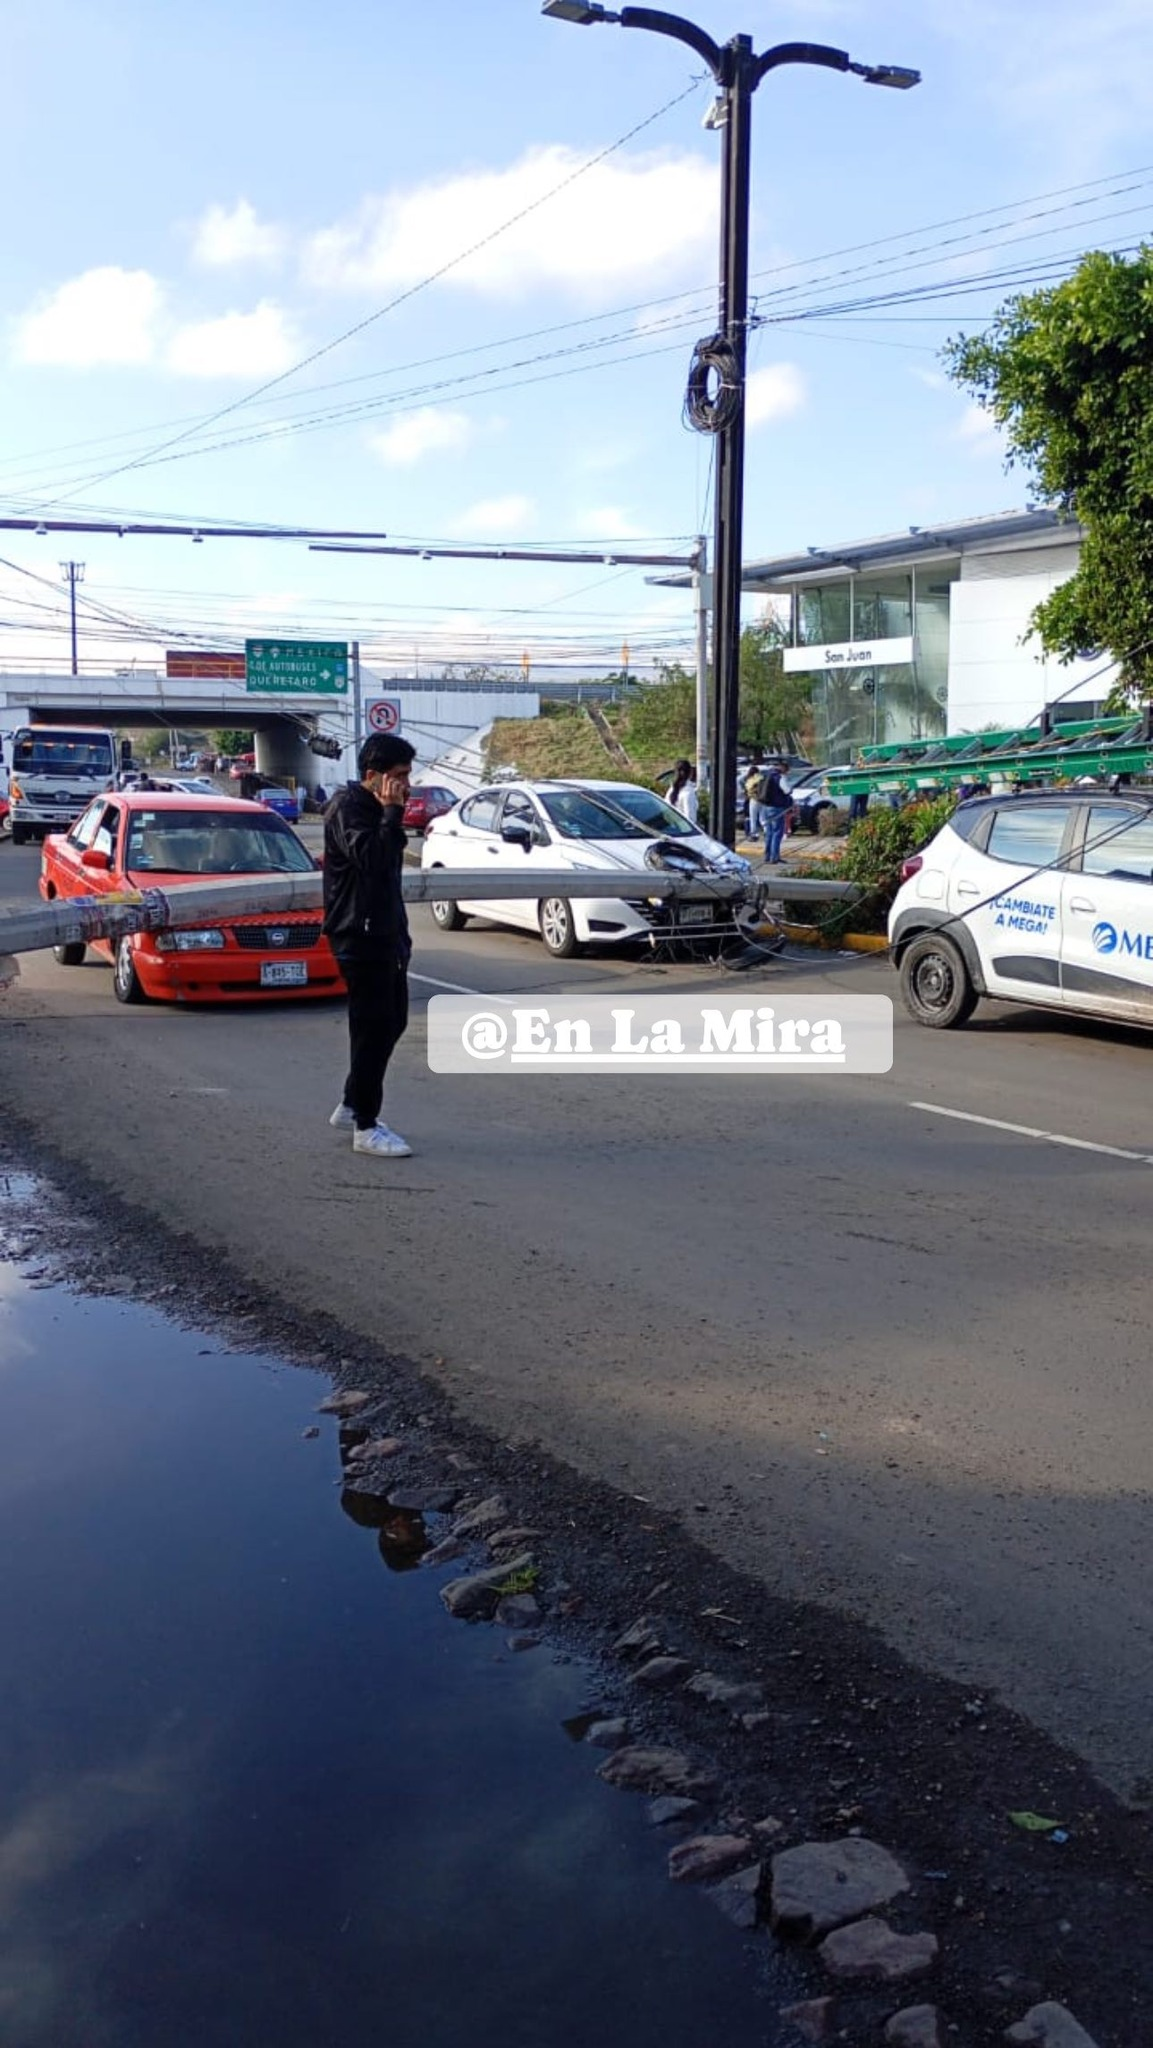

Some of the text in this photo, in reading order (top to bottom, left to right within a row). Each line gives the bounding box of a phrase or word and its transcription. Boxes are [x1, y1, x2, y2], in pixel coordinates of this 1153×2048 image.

[825, 647, 872, 663] San Juan
[270, 661, 317, 672] AUTOBUSES
[249, 675, 317, 687] QUERETARO
[994, 913, 1048, 936] A MEGA!
